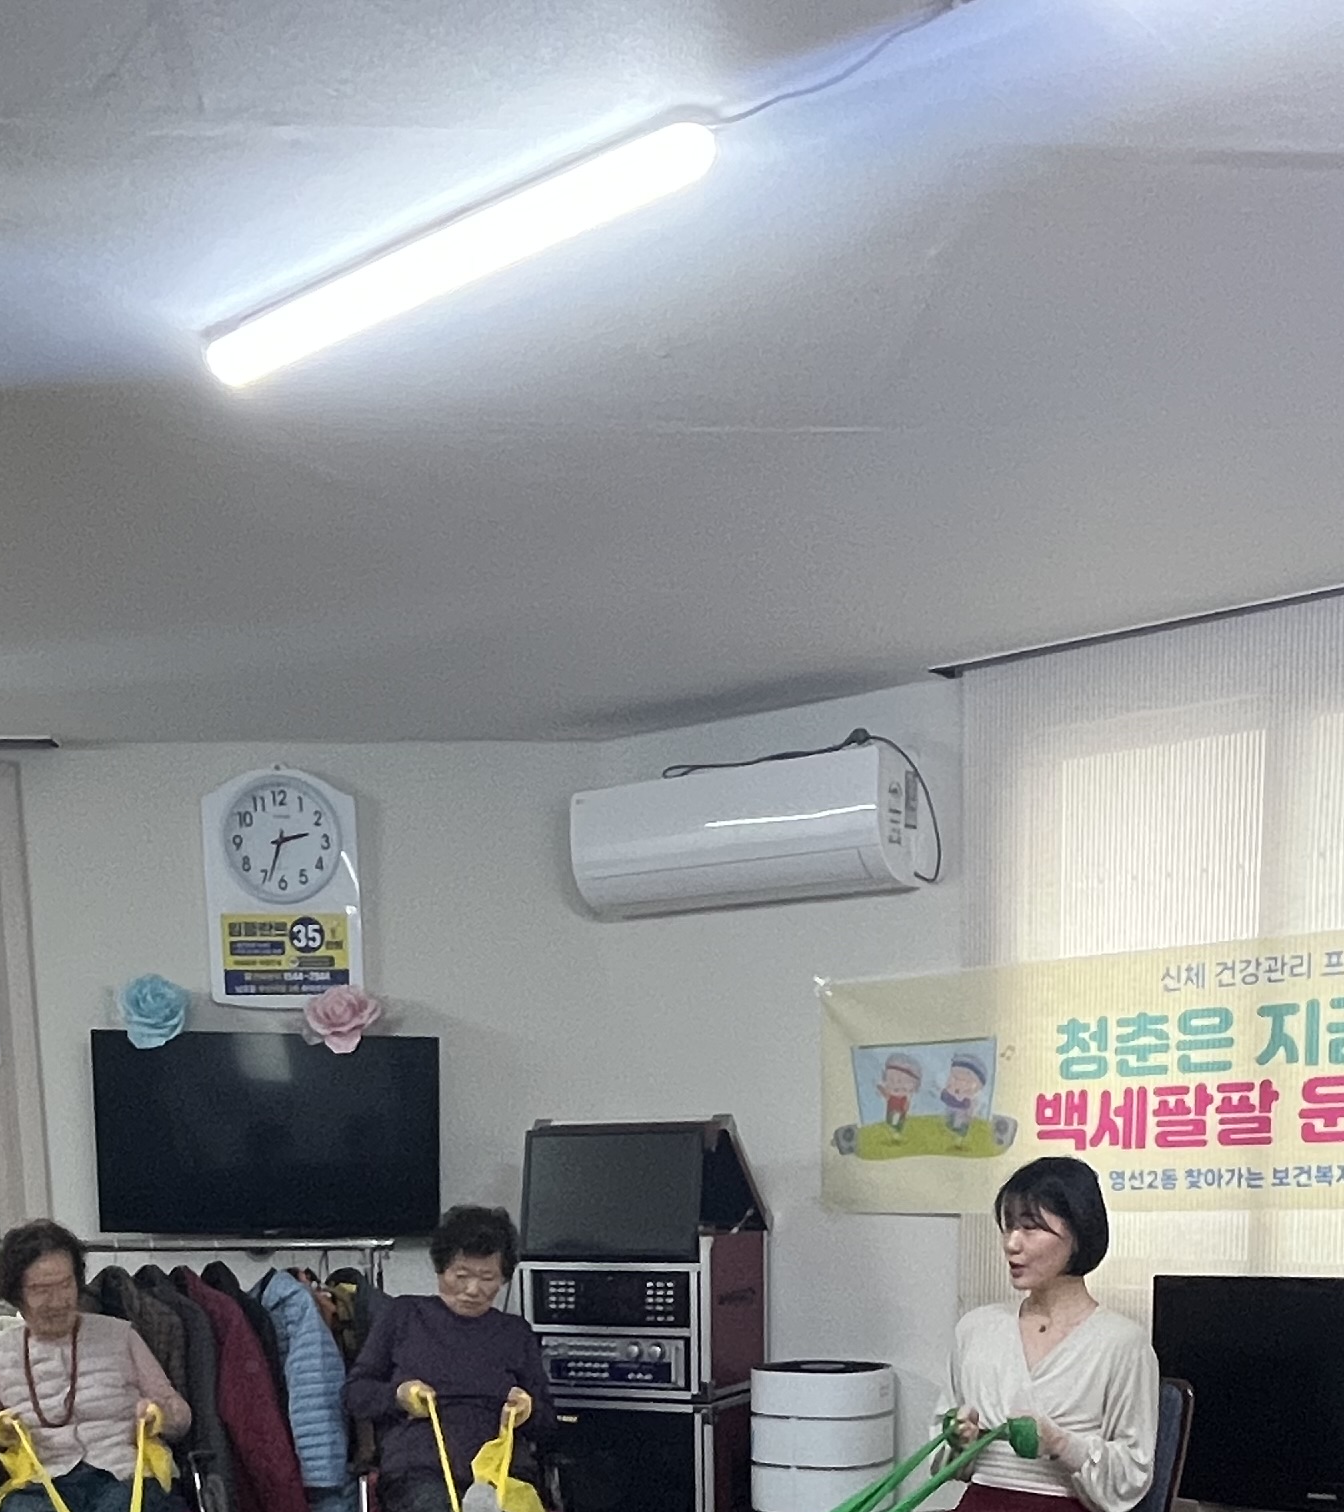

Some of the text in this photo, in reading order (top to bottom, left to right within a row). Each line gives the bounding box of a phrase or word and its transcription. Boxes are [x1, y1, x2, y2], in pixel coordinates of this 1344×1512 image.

[252, 795, 266, 812] 11
[271, 789, 287, 806] 12
[297, 796, 304, 812] 1
[237, 811, 253, 828] 10
[313, 810, 323, 826] 2
[232, 834, 243, 851] 9
[320, 833, 331, 850] 3
[242, 855, 252, 872] 8
[314, 856, 324, 871] 4
[260, 869, 268, 885] 7
[278, 874, 288, 891] 6
[299, 868, 309, 885] 5
[292, 924, 321, 948] 35
[1160, 963, 1205, 992] 신체
[1215, 953, 1312, 988] 건강관리
[1056, 1007, 1234, 1080] 청춘은
[1033, 1078, 1280, 1151] 백세팔팔
[1109, 1168, 1178, 1191] 영선2동
[1184, 1166, 1265, 1190] 찾아가는
